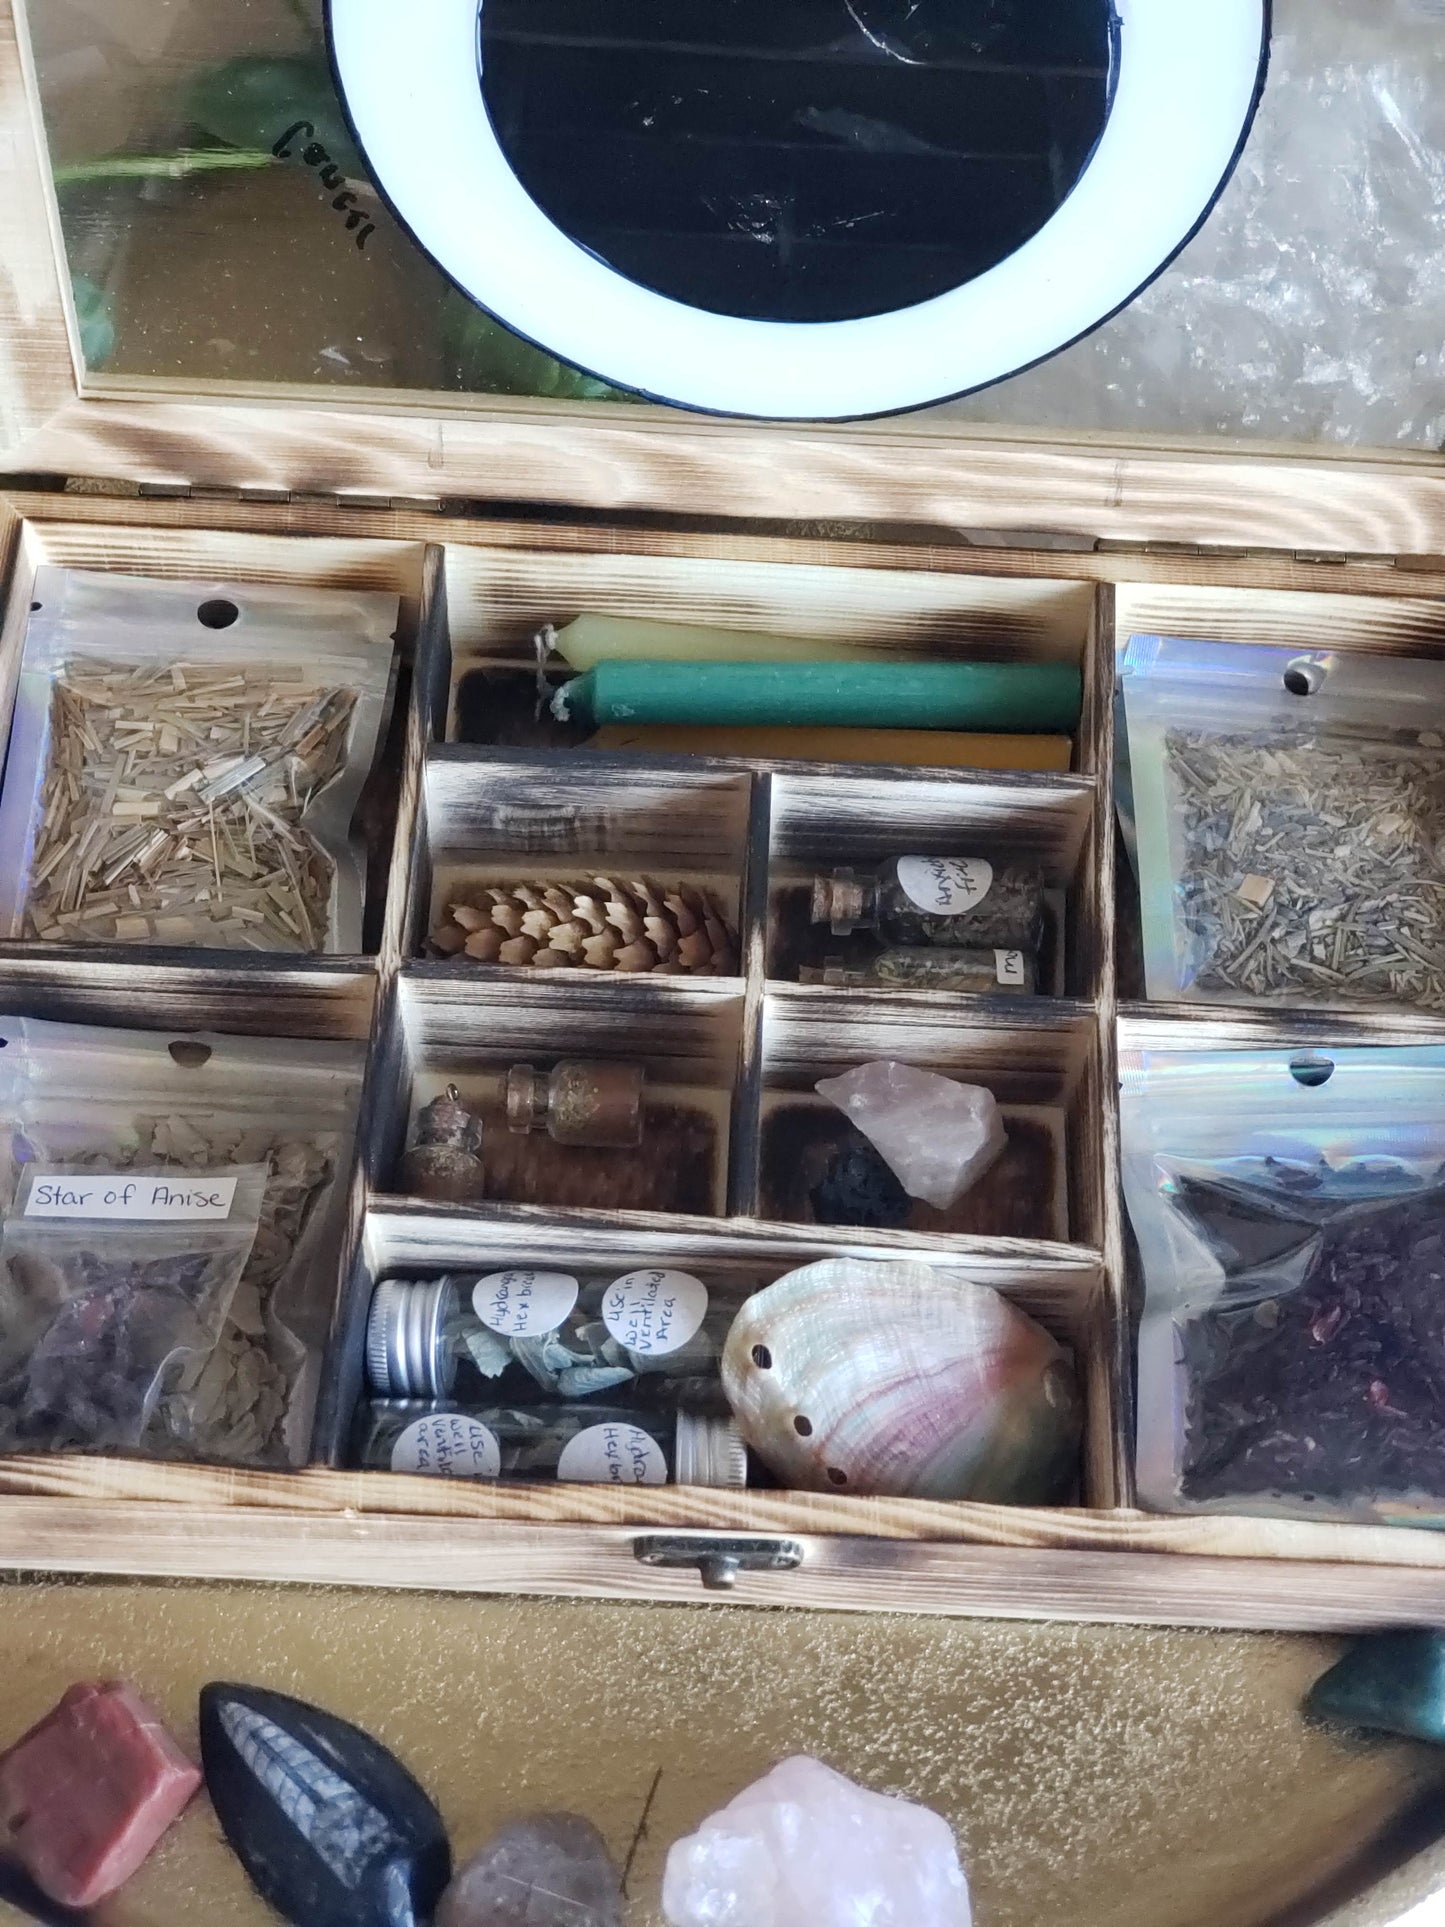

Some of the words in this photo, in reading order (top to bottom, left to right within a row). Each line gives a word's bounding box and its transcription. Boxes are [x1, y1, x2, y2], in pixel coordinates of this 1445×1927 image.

[35, 1185, 93, 1206] Star
[103, 1183, 136, 1206] of
[151, 1186, 226, 1207] Anise
[616, 1277, 635, 1290] in
[512, 1302, 530, 1332] Hex
[655, 1297, 676, 1341] Area
